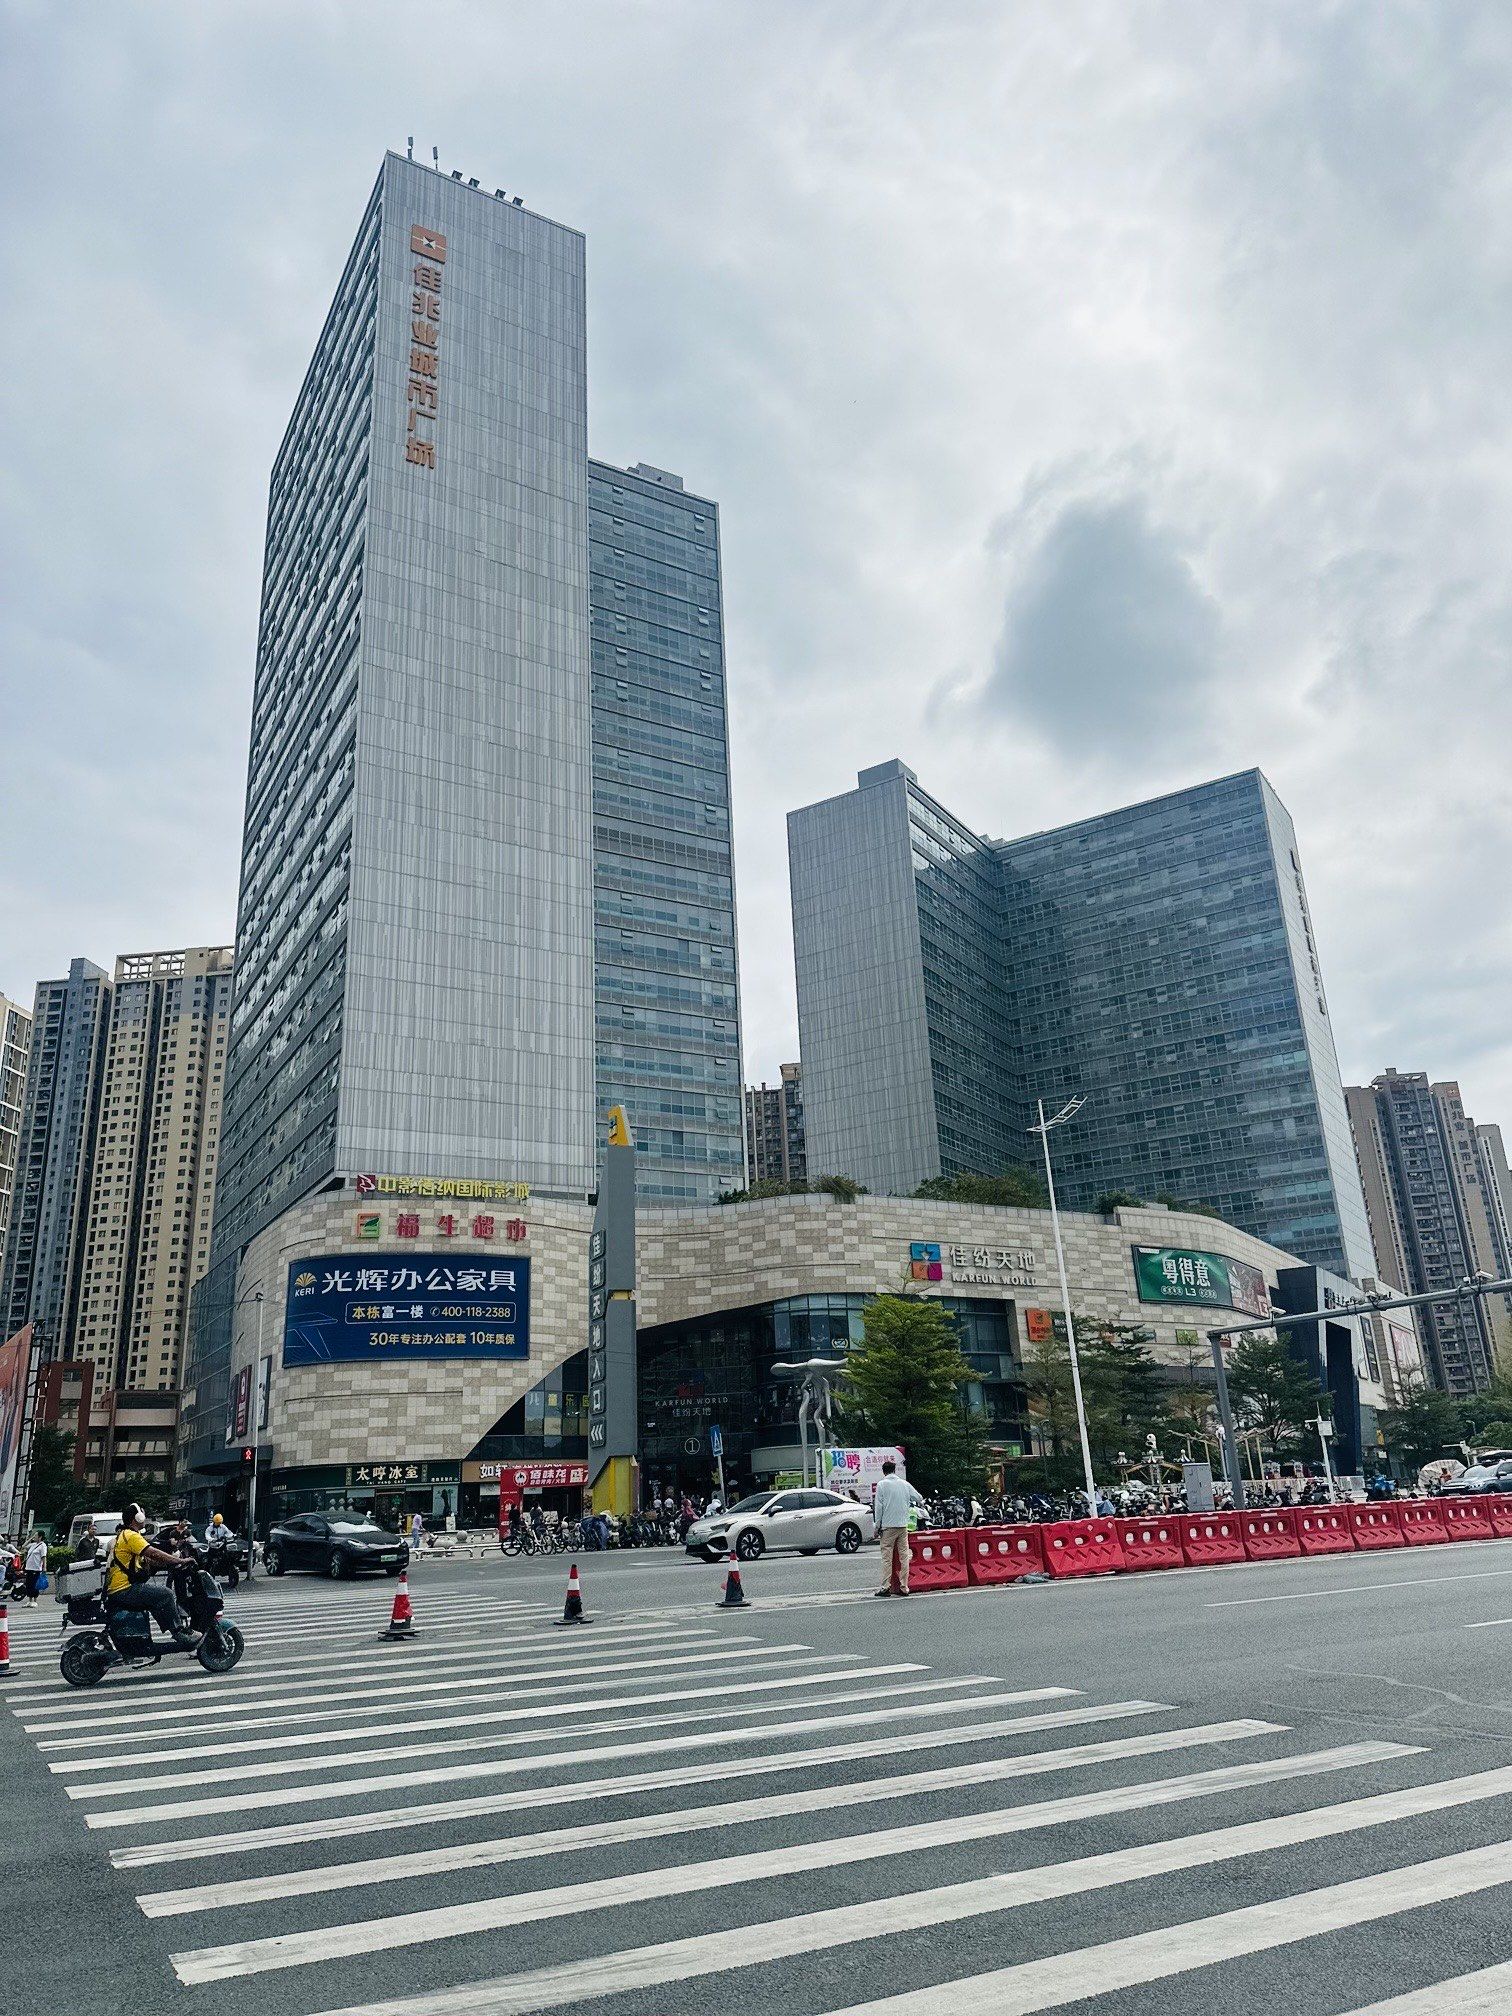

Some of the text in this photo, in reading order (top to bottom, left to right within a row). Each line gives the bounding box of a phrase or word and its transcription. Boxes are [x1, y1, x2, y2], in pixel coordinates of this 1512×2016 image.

[405, 262, 442, 470] 佳兆业城市广场
[396, 1213, 527, 1241] 福生超市
[950, 1245, 1036, 1272] 佳纷天地
[321, 1268, 517, 1294] 光辉办公家具
[952, 1273, 1038, 1287] KARFUN WORLD
[1161, 1257, 1211, 1287] 粤得意
[295, 1287, 315, 1297] KERI
[441, 1306, 512, 1318] 400-118-2388
[369, 1331, 516, 1346] 30年专注办公配套 10年质保
[672, 1407, 712, 1417] 佳纷天地
[831, 1450, 861, 1477] 招聘
